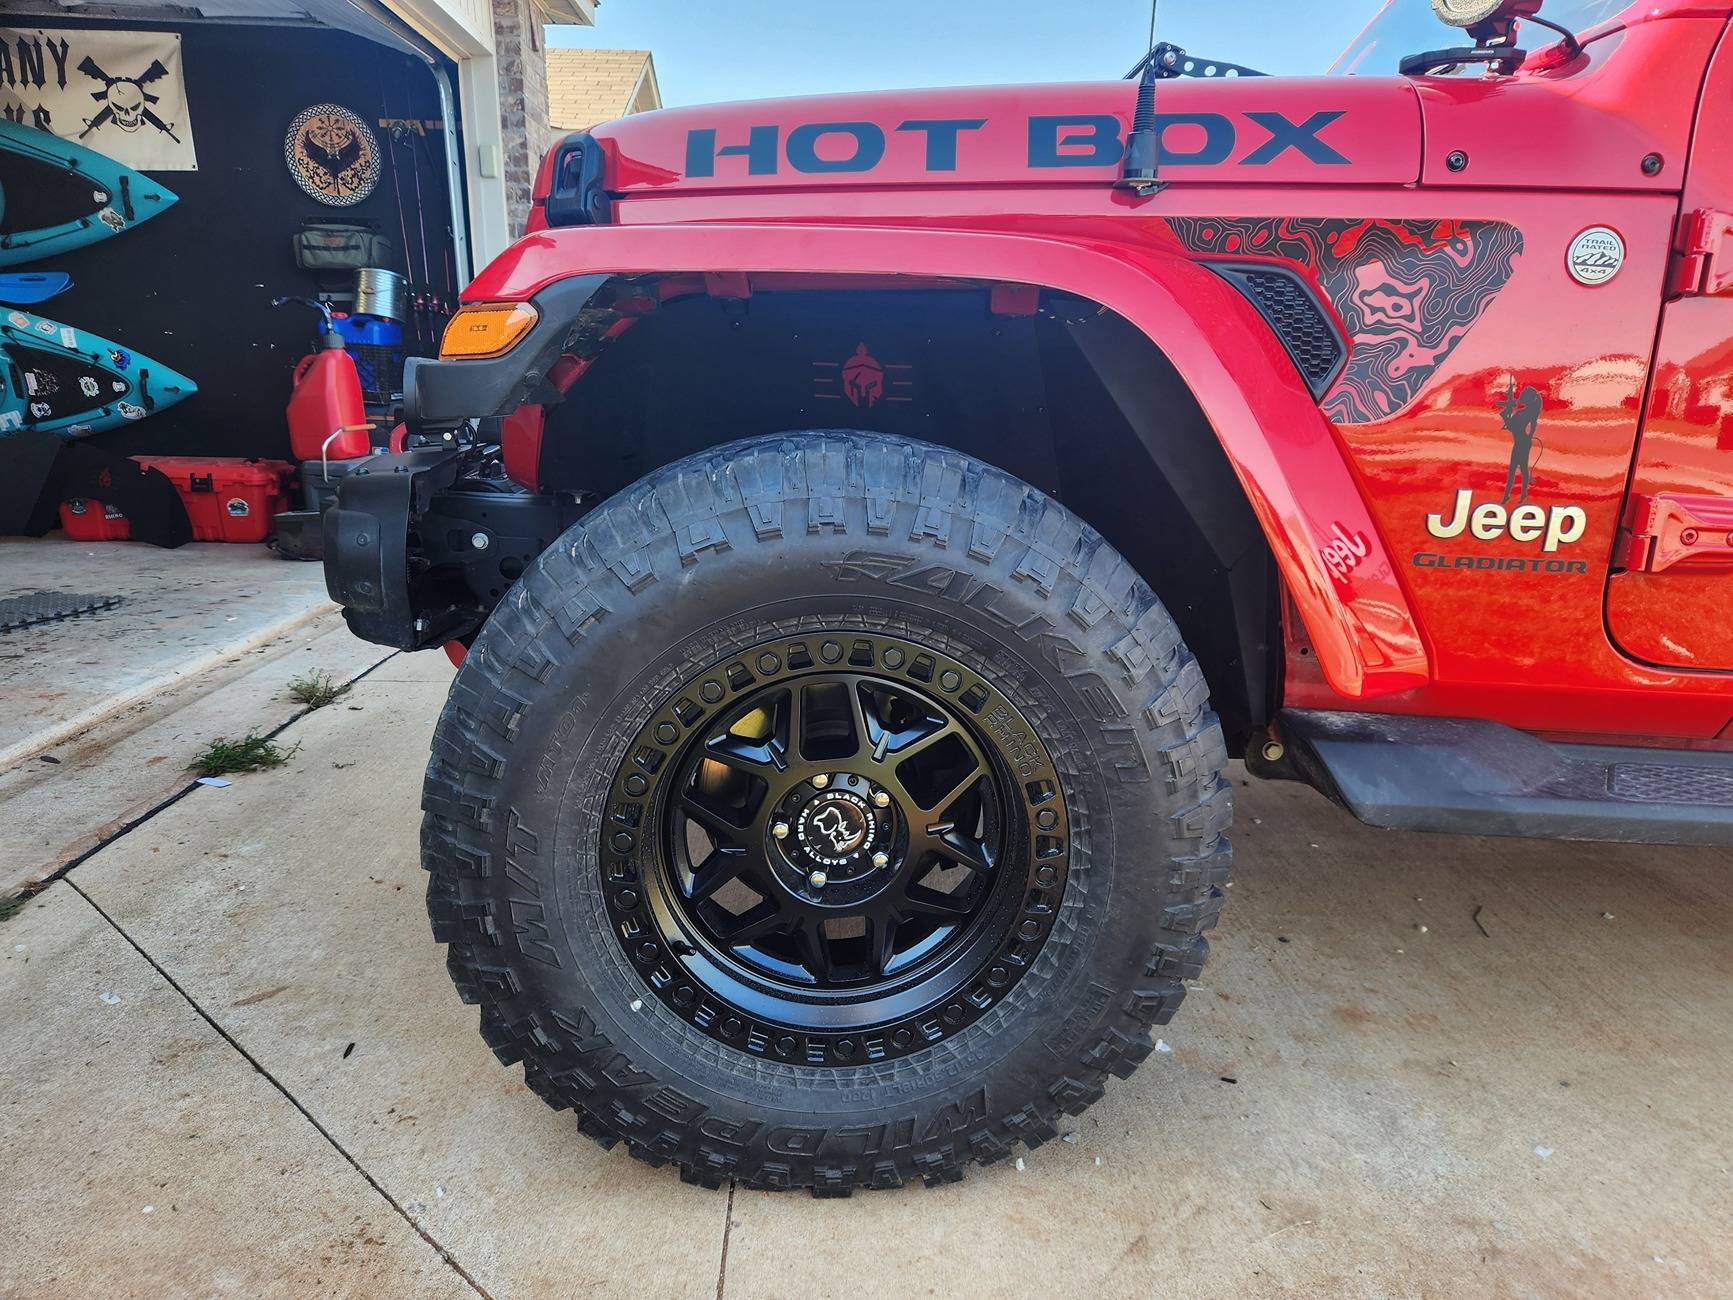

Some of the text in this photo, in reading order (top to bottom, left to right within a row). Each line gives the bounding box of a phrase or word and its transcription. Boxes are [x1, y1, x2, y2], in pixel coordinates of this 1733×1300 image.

[685, 110, 1352, 178] HOT BOX
[1581, 244, 1616, 252] RATED
[1584, 238, 1614, 246] TRAIL
[1425, 488, 1588, 552] Jeep
[1412, 552, 1588, 575] GLADIATOR
[983, 714, 1032, 777] RHINO
[991, 704, 1045, 768] BLACK
[797, 808, 848, 866] HARD ALLOYS
[826, 792, 876, 850] BLACK RHINO
[553, 1004, 992, 1157] WILDPEAK
